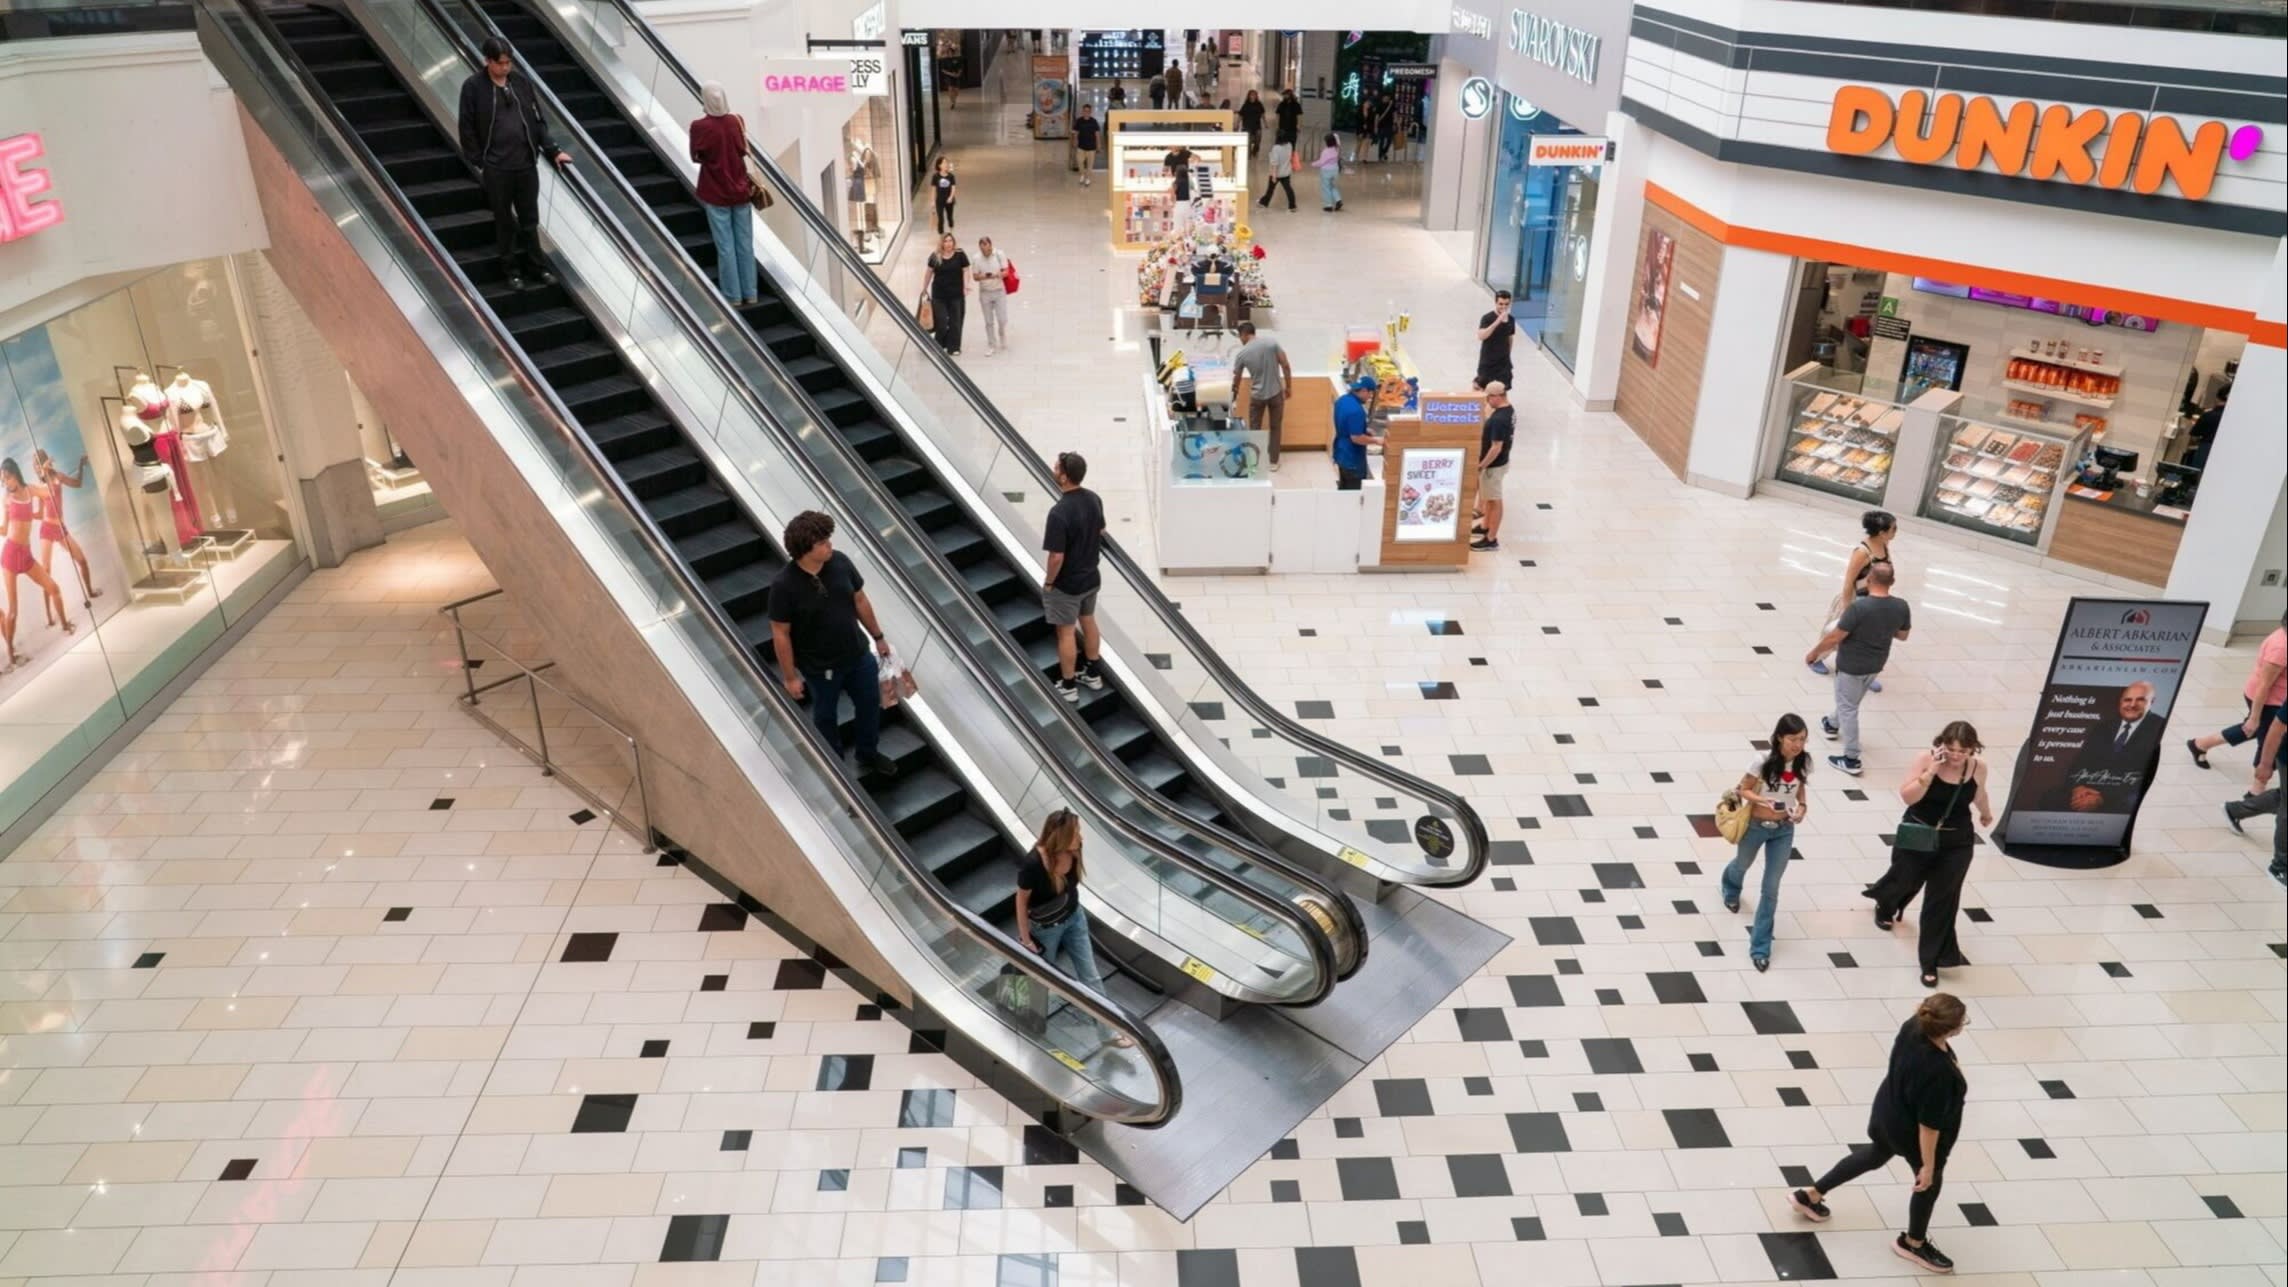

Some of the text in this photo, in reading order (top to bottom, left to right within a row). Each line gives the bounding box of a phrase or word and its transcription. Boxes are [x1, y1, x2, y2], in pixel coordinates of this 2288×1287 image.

[900, 32, 928, 45] VANS
[1508, 8, 1599, 84] SWAROVSKI
[765, 75, 846, 92] GARAGE
[1826, 85, 2264, 200] DUNKIN'
[1535, 145, 1604, 159] DUNKIN'
[1882, 301, 1894, 314] A
[1421, 459, 1454, 470] BERRY
[1406, 470, 1436, 480] SWEET
[2070, 627, 2191, 643] ALBERT ABKARIAN
[2090, 641, 2161, 654] & ASSOCIATES
[2051, 694, 2097, 706] Nothing is
[2044, 709, 2065, 720] just
[2042, 726, 2065, 736] every
[2038, 739, 2085, 750] is personal
[2033, 754, 2043, 762] to
[1766, 783, 1797, 794] NY
